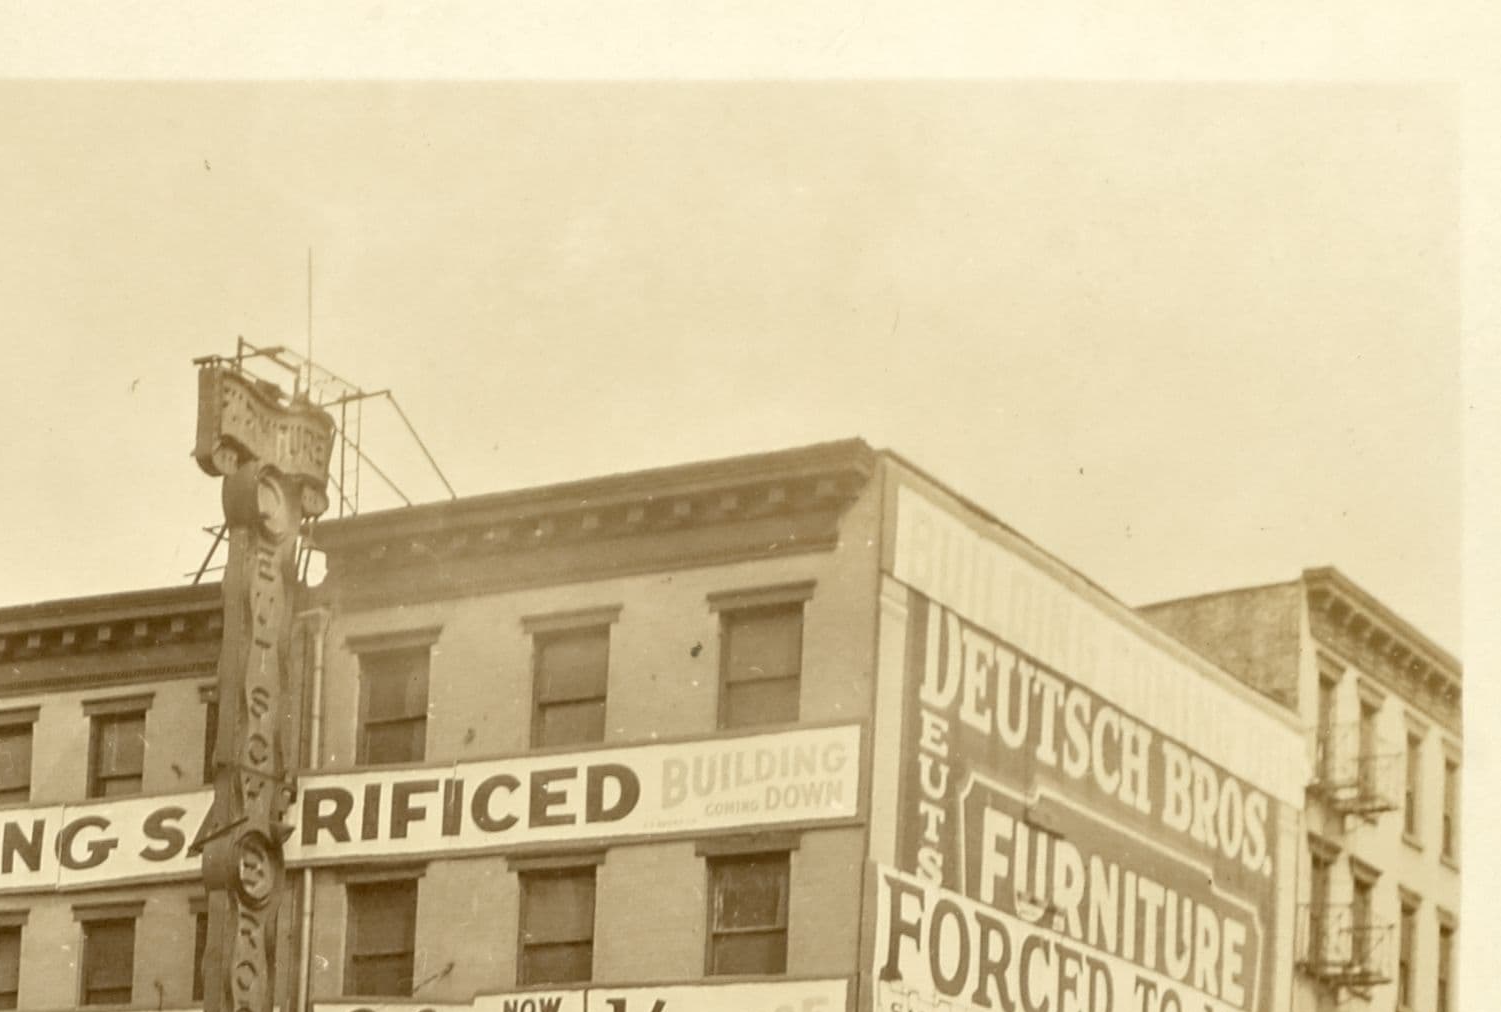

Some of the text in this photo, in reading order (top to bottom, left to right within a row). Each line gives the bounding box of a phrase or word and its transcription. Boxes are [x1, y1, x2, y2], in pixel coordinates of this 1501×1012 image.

[661, 741, 848, 809] BUILDING
[919, 602, 1272, 876] DEUTSCH BROS.
[142, 763, 641, 861] SRIFICED
[705, 780, 844, 817] COMING DOWN
[980, 807, 1247, 1009] FURNITURE
